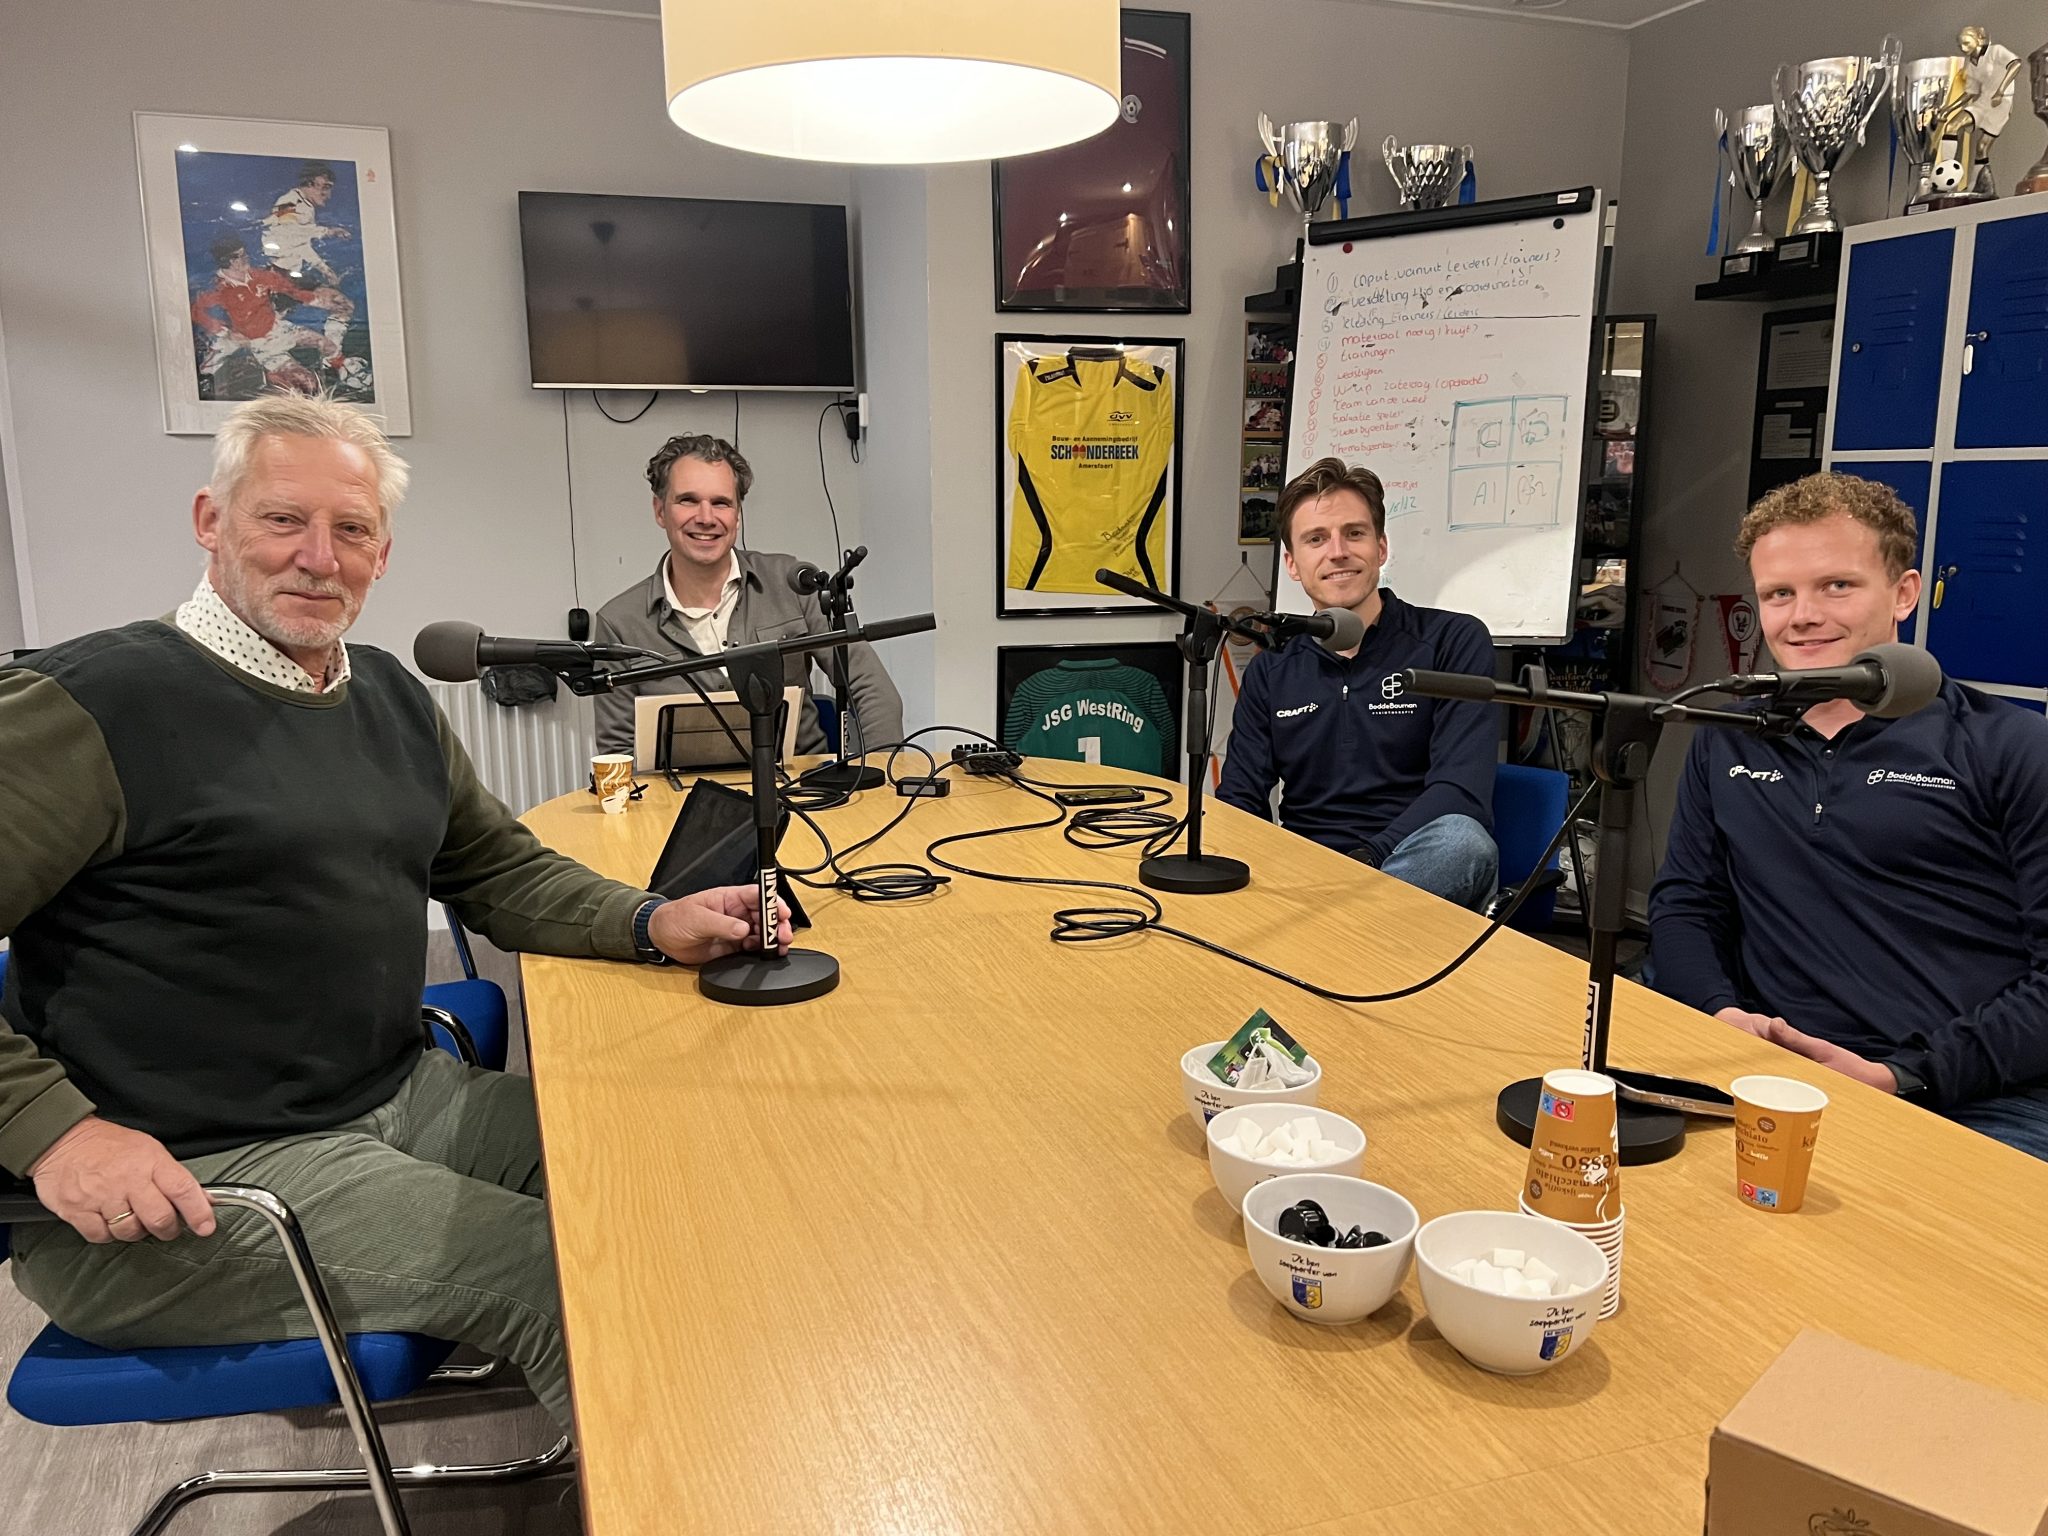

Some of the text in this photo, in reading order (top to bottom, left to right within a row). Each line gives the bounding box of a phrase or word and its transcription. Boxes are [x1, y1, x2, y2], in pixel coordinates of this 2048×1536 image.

[1041, 699, 1144, 734] JSG WestRing
[1276, 704, 1310, 718] CRAFT
[1886, 771, 1956, 786] BoddeBouman
[1306, 1257, 1320, 1267] ben
